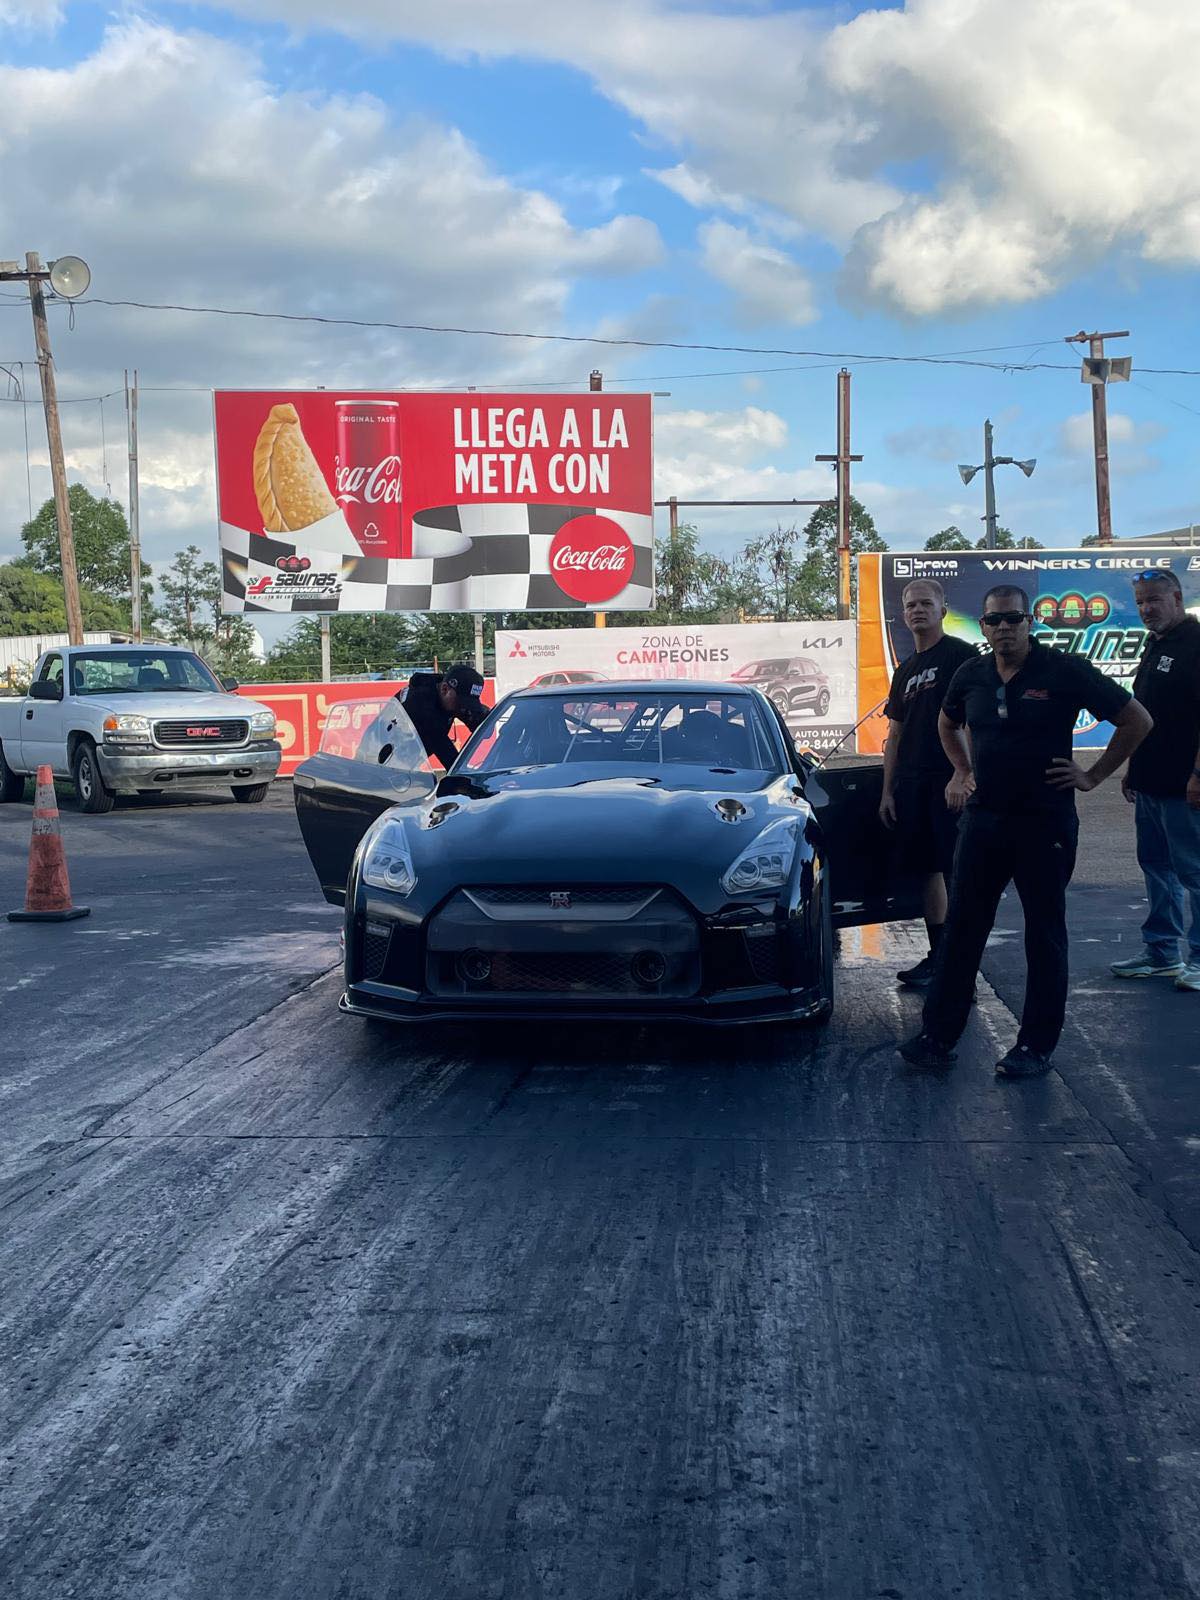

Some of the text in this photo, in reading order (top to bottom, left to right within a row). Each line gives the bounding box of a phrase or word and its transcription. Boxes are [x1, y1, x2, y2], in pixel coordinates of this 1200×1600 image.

[453, 408, 629, 448] LLEGA A LA
[454, 453, 610, 494] META CON
[553, 545, 630, 571] Coca-Cola
[913, 558, 958, 569] brava
[983, 557, 1170, 571] WINNERS CIRCLE
[642, 635, 703, 648] ZONA DE
[616, 648, 729, 664] CAMPEONES
[186, 727, 220, 737] GMC
[795, 729, 845, 738] AUTO MALL
